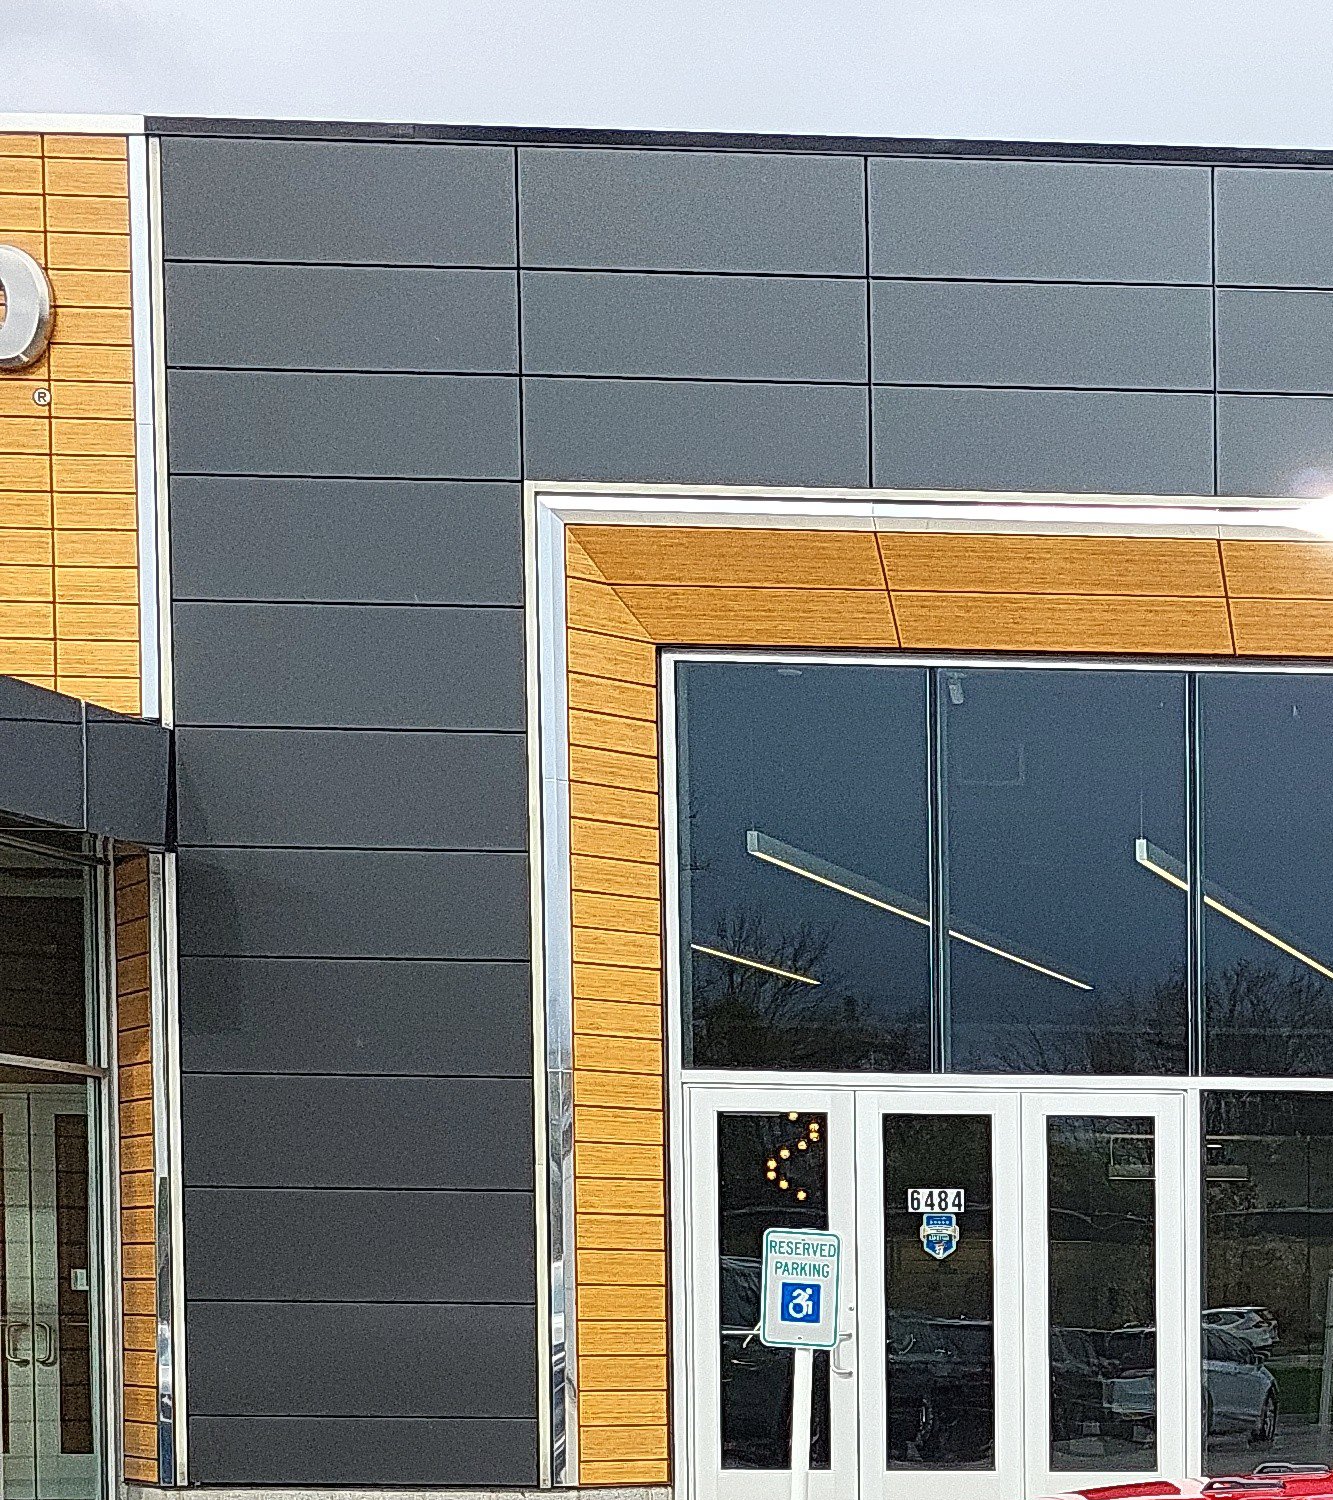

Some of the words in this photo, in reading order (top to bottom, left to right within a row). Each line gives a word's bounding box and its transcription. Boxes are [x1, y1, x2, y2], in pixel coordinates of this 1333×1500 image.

[910, 1189, 962, 1212] 6484
[769, 1239, 836, 1258] RESERVED
[774, 1260, 830, 1278] PARKING
